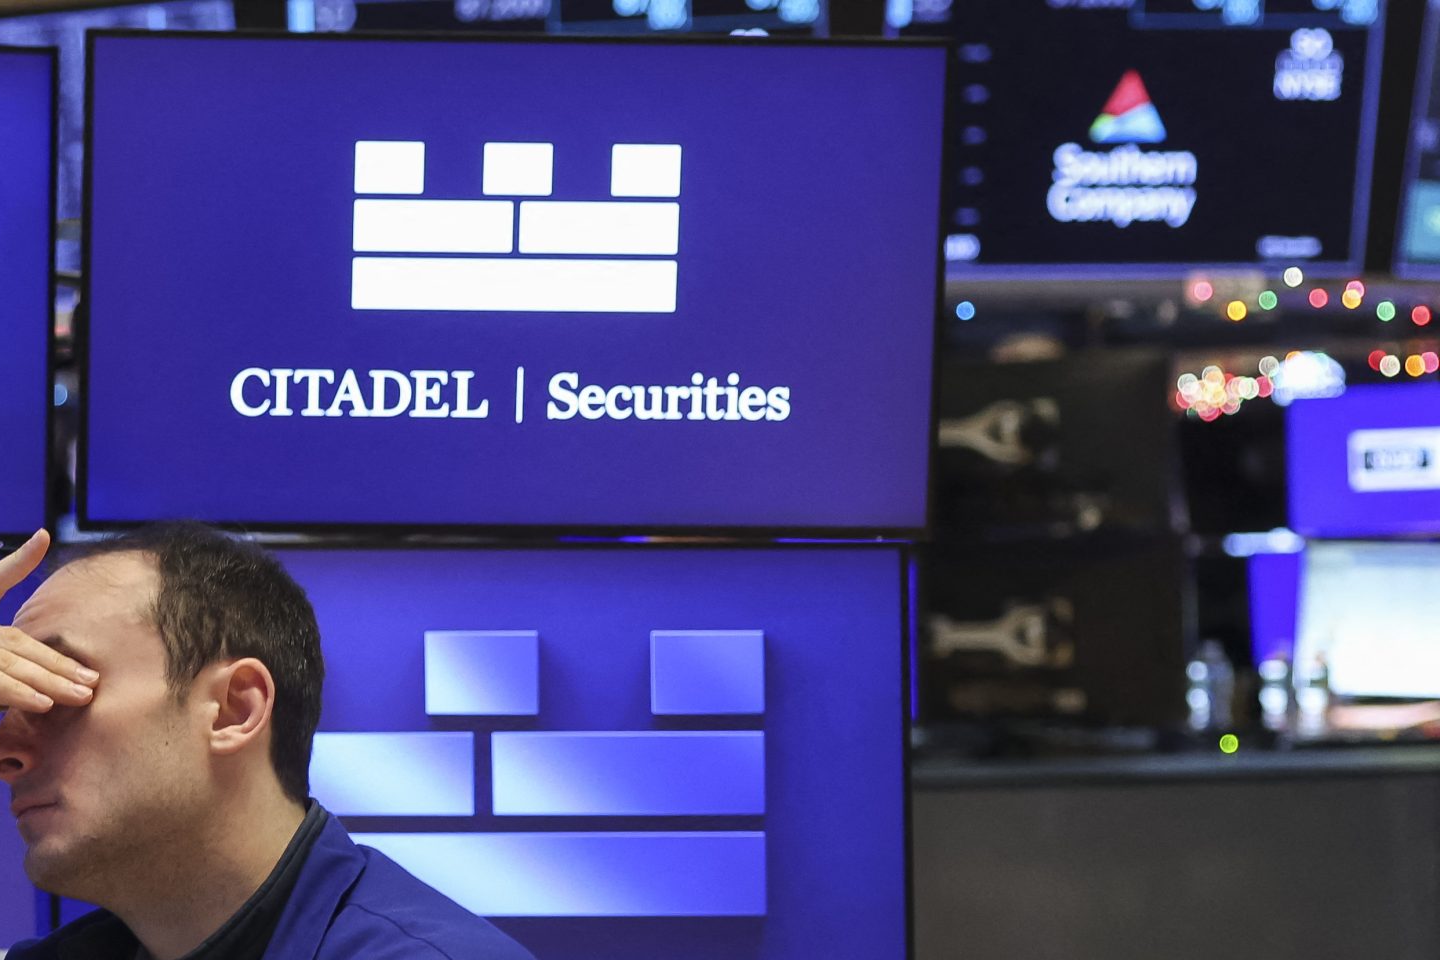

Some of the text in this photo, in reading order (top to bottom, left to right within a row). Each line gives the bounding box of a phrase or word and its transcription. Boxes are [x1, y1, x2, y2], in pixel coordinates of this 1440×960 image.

[1051, 142, 1197, 186] Southern
[1046, 182, 1197, 228] Company
[229, 366, 791, 423] CITADEL Securities
